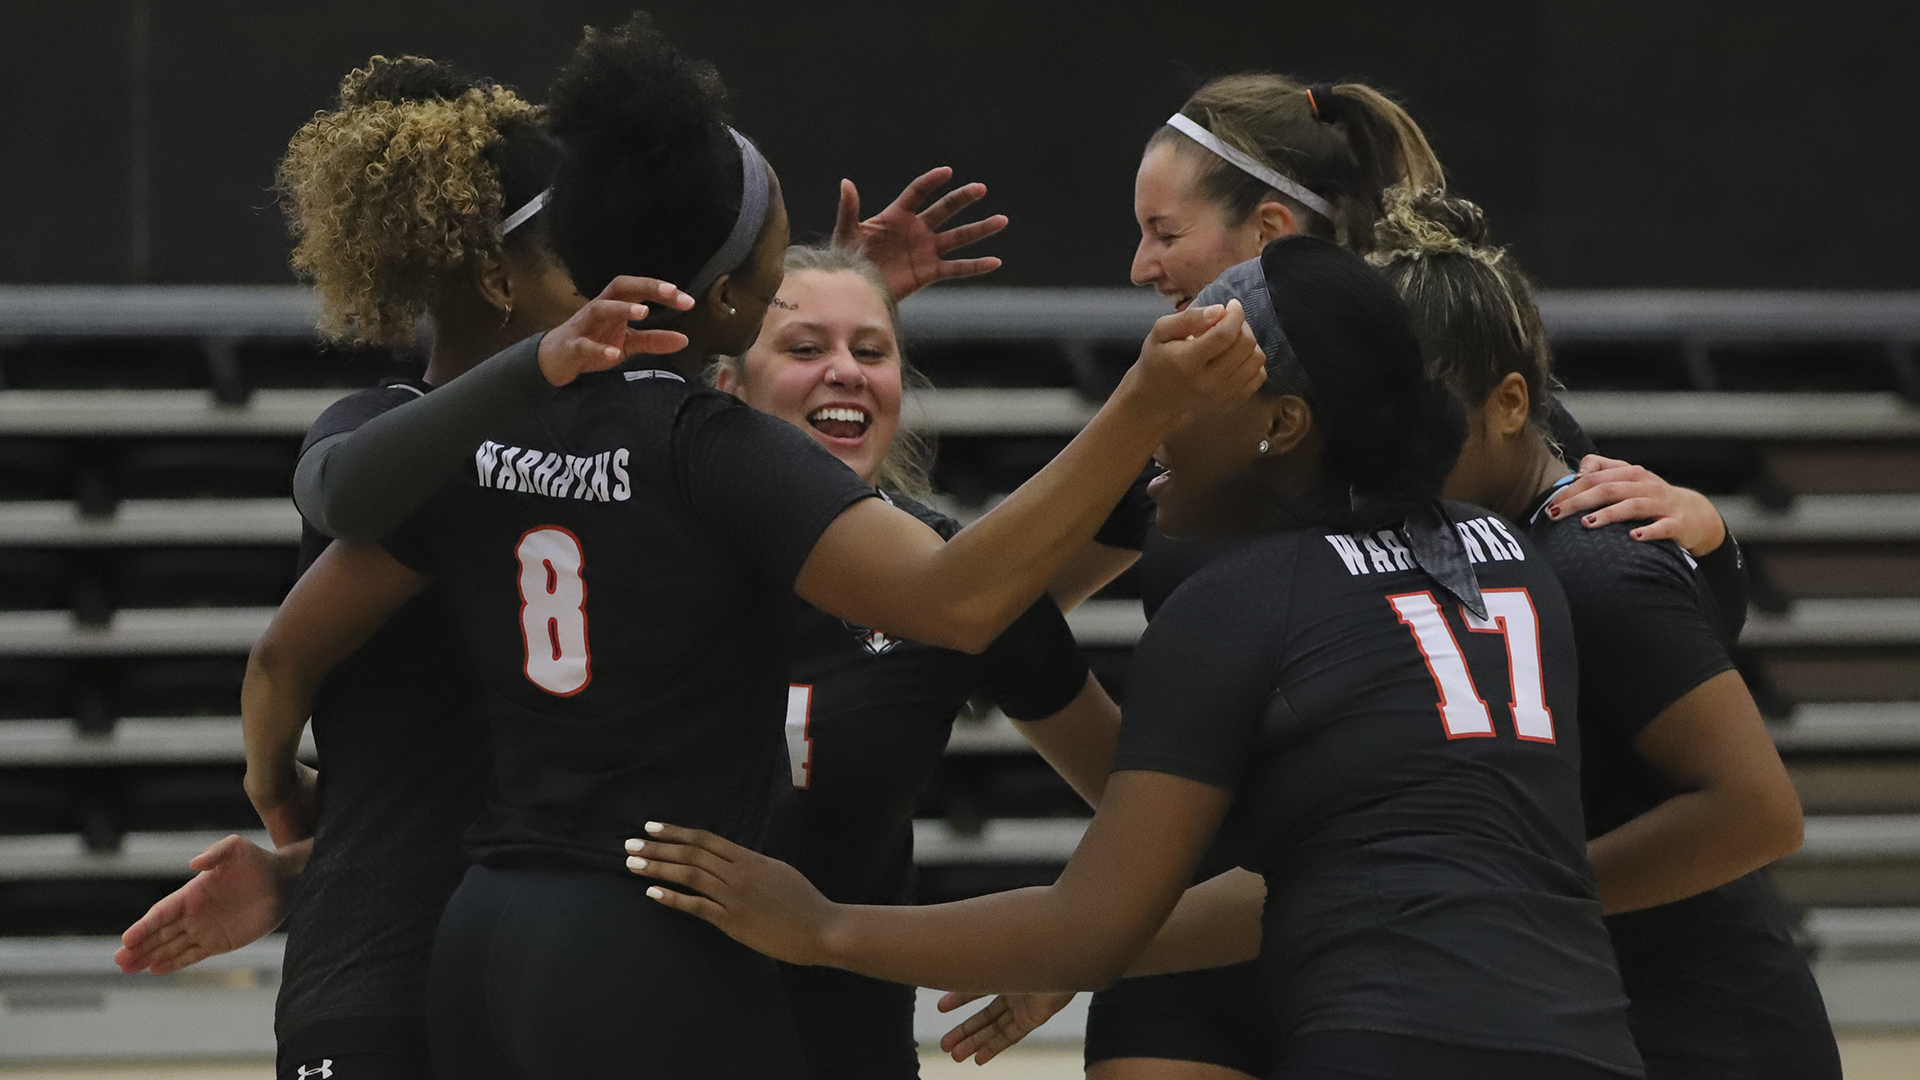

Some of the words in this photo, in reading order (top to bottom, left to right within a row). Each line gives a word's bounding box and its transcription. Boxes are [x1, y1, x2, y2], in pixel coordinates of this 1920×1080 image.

[475, 439, 631, 502] WARHAWKS
[1325, 516, 1525, 576] WARWKS
[514, 524, 592, 698] 8
[1385, 587, 1556, 745] 17
